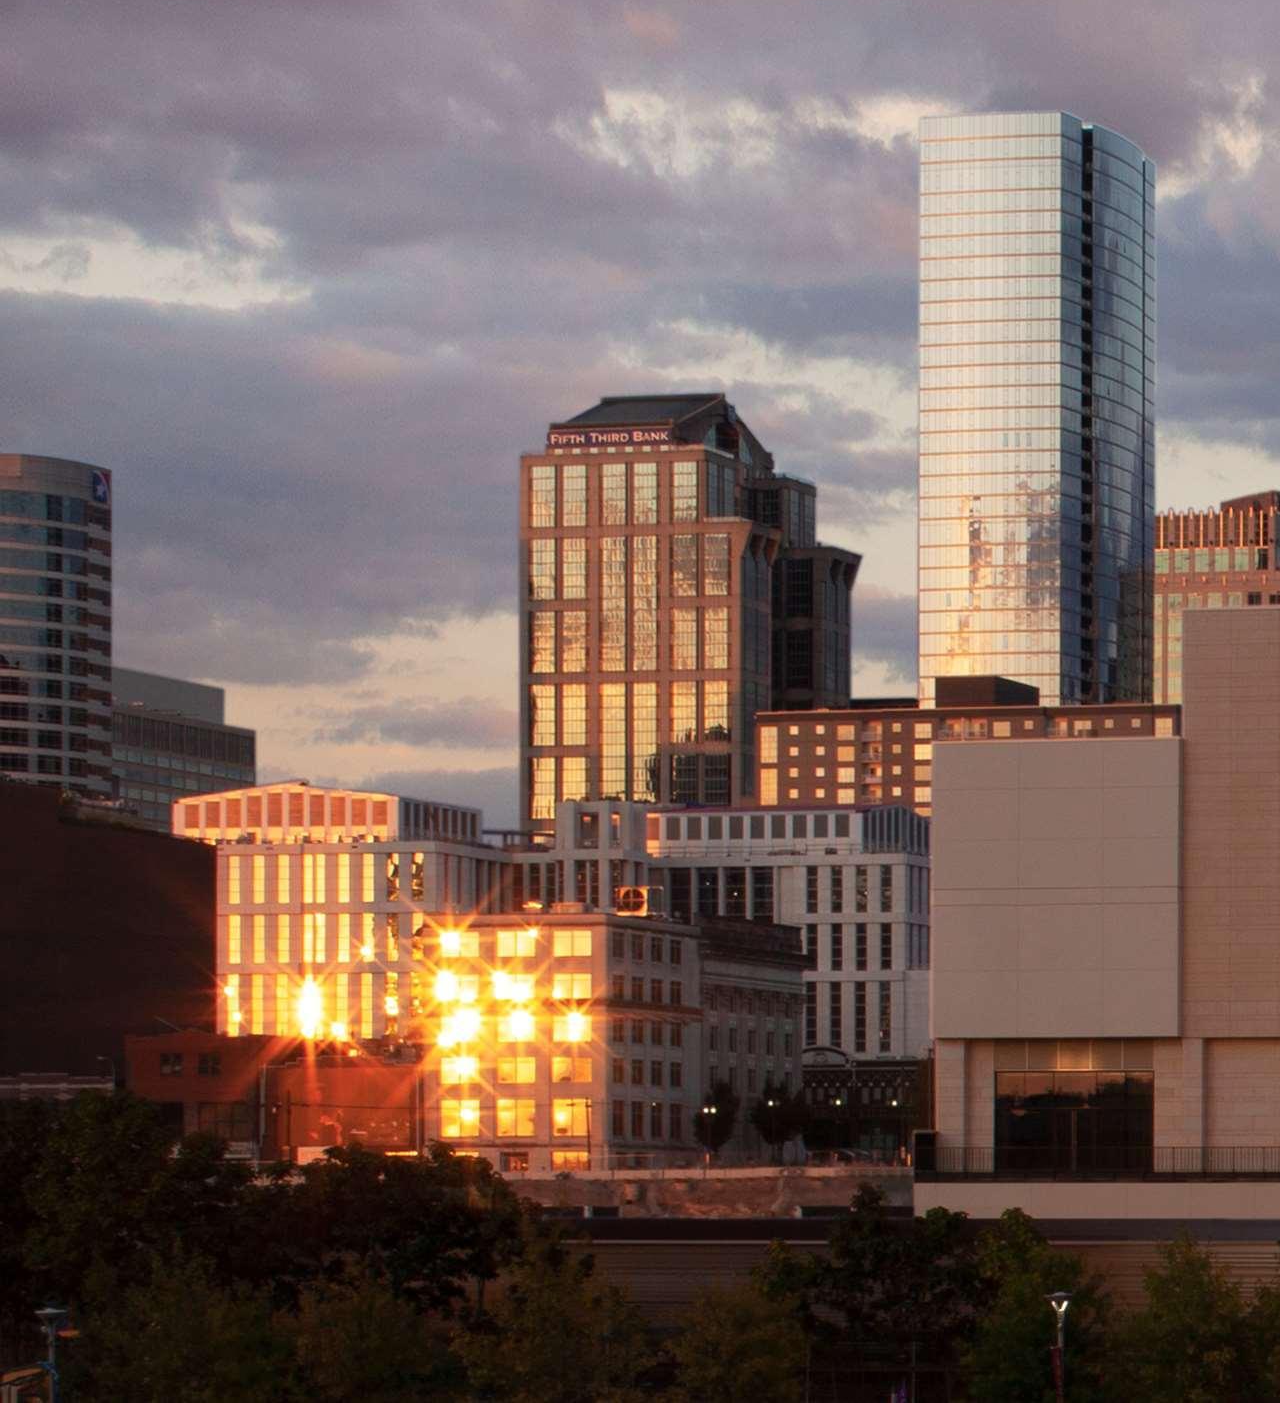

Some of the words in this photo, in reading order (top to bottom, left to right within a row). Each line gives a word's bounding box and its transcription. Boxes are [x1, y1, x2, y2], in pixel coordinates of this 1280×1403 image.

[551, 434, 585, 445] FIFTH
[590, 432, 629, 443] THIRD
[632, 431, 669, 442] BANK
